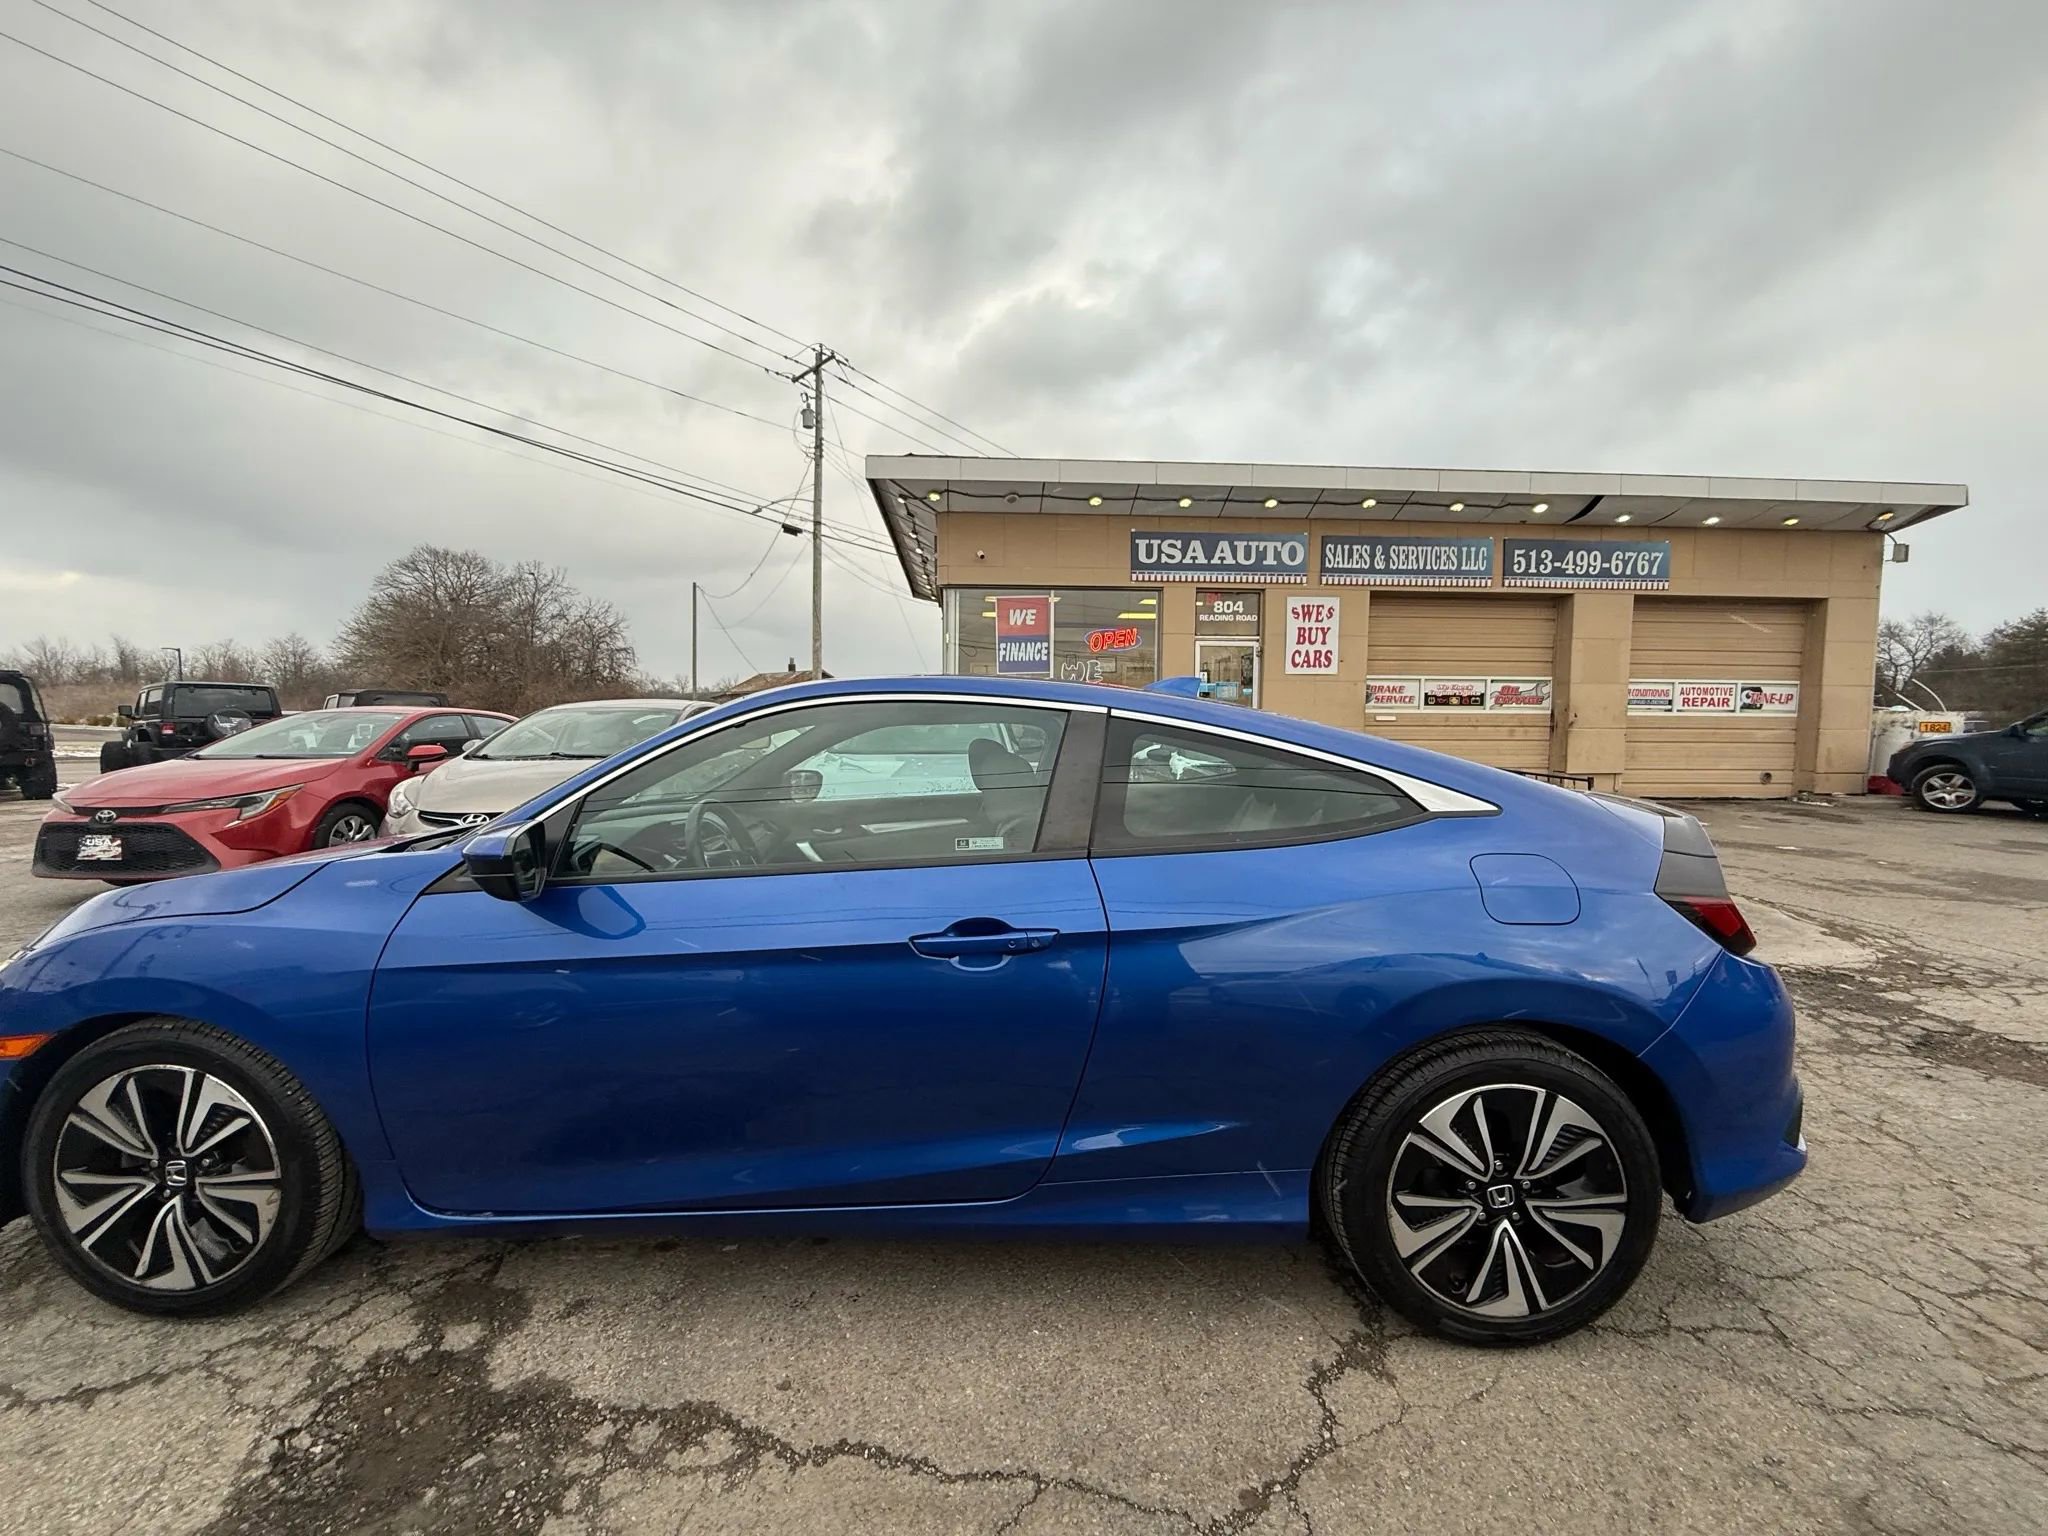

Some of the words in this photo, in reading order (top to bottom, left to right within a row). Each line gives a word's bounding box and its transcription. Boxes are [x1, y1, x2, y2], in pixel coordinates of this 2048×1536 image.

[1135, 539, 1208, 564] USA
[1210, 540, 1305, 566] AUTO
[1325, 543, 1370, 569] SALES
[1374, 544, 1385, 570] &
[1389, 545, 1458, 570] SERVICES
[1461, 546, 1487, 571] LLC
[1513, 549, 1664, 576] 513-499-6767
[1213, 600, 1244, 613] 804
[1009, 608, 1037, 626] WE
[1199, 614, 1234, 622] READING
[1235, 614, 1258, 622] ROAD
[1089, 627, 1138, 653] OPEN
[1296, 626, 1331, 646] BUY
[999, 641, 1049, 662] FINANCE
[1291, 649, 1333, 669] CARS
[1370, 685, 1406, 695] BRAKE
[1680, 687, 1734, 697] AUTOMOTIVE
[1374, 695, 1416, 705] SERVICE
[1682, 697, 1730, 708] REPAIR
[1750, 692, 1794, 705] TUNE-UP
[1923, 723, 1948, 732] 1824
[86, 838, 113, 846] USA
